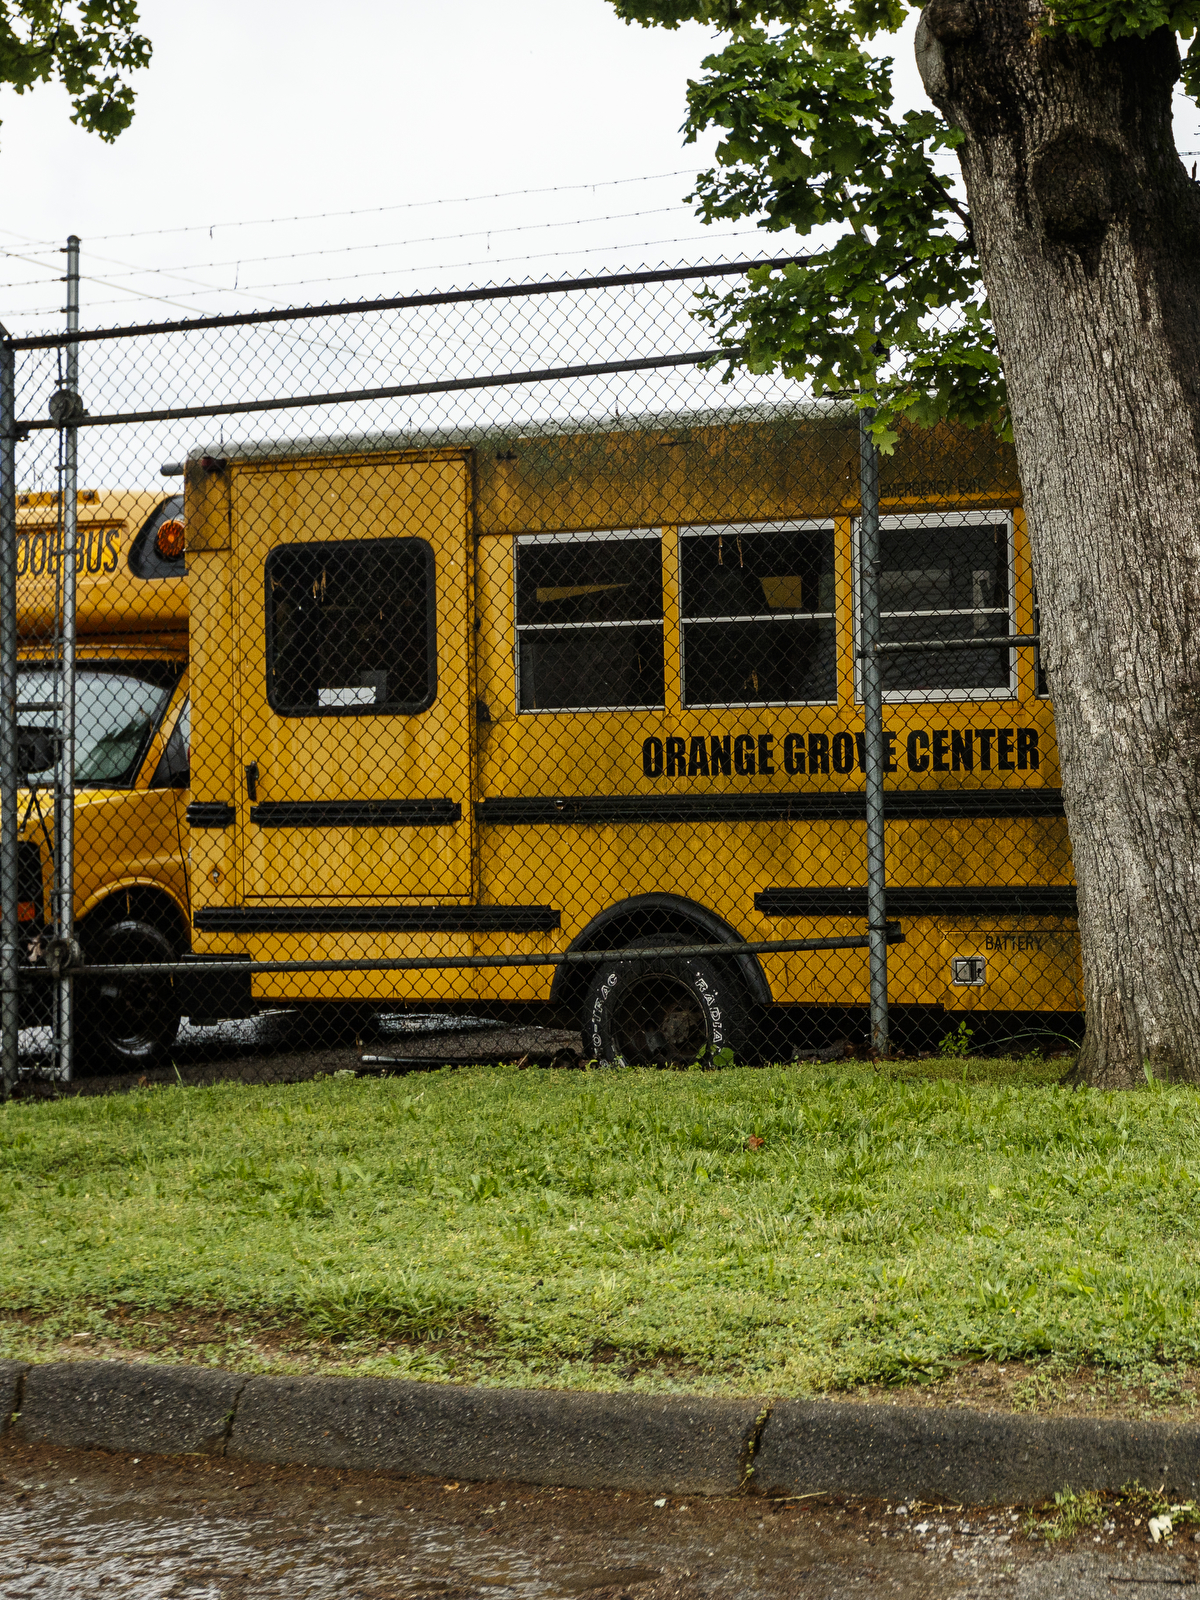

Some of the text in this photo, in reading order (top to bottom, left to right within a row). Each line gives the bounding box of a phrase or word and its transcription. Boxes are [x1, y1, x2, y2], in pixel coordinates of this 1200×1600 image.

[642, 734, 775, 778] ORANGE
[906, 728, 1040, 773] CENTER
[985, 935, 1043, 951] BATTERY
